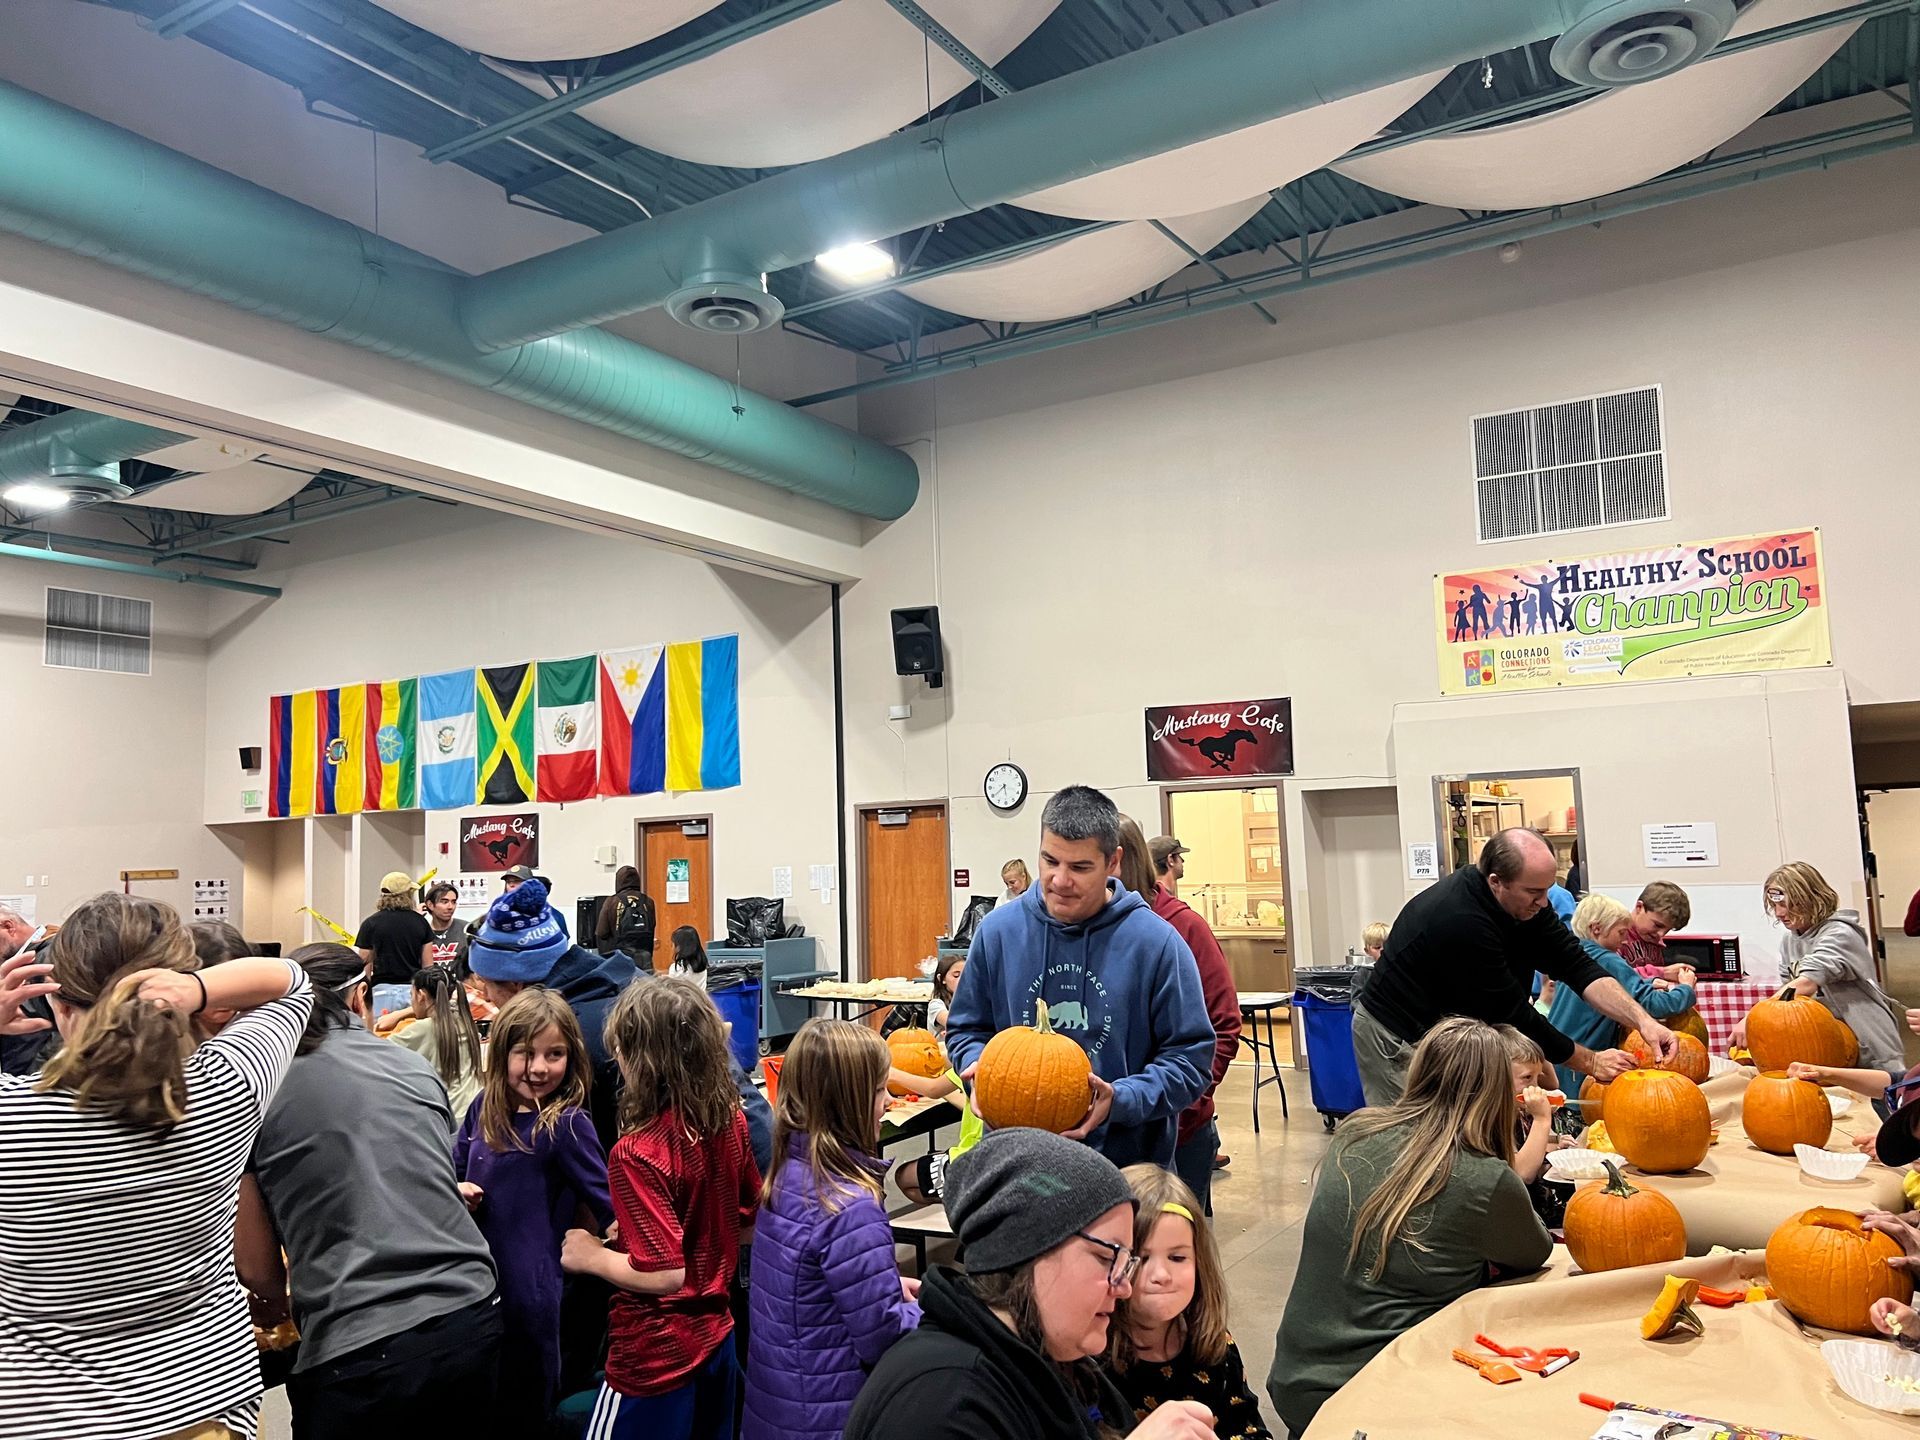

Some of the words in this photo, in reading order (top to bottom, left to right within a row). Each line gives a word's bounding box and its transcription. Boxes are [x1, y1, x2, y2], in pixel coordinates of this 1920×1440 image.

[1557, 560, 1683, 594] HEALTHY
[1697, 546, 1807, 578] SCHOOL
[1574, 573, 1809, 635] Champion
[1500, 646, 1549, 660] COLORADO
[1583, 636, 1620, 645] COLORADO
[1584, 643, 1620, 653] LEGACY
[1501, 657, 1551, 668] CONNECTIONS
[1152, 710, 1231, 741] Mustang
[1237, 705, 1284, 734] Cafe
[463, 820, 507, 843] Mustang
[510, 817, 535, 839] Cafe
[1048, 963, 1082, 976] NORTH
[1085, 970, 1107, 998] FACE
